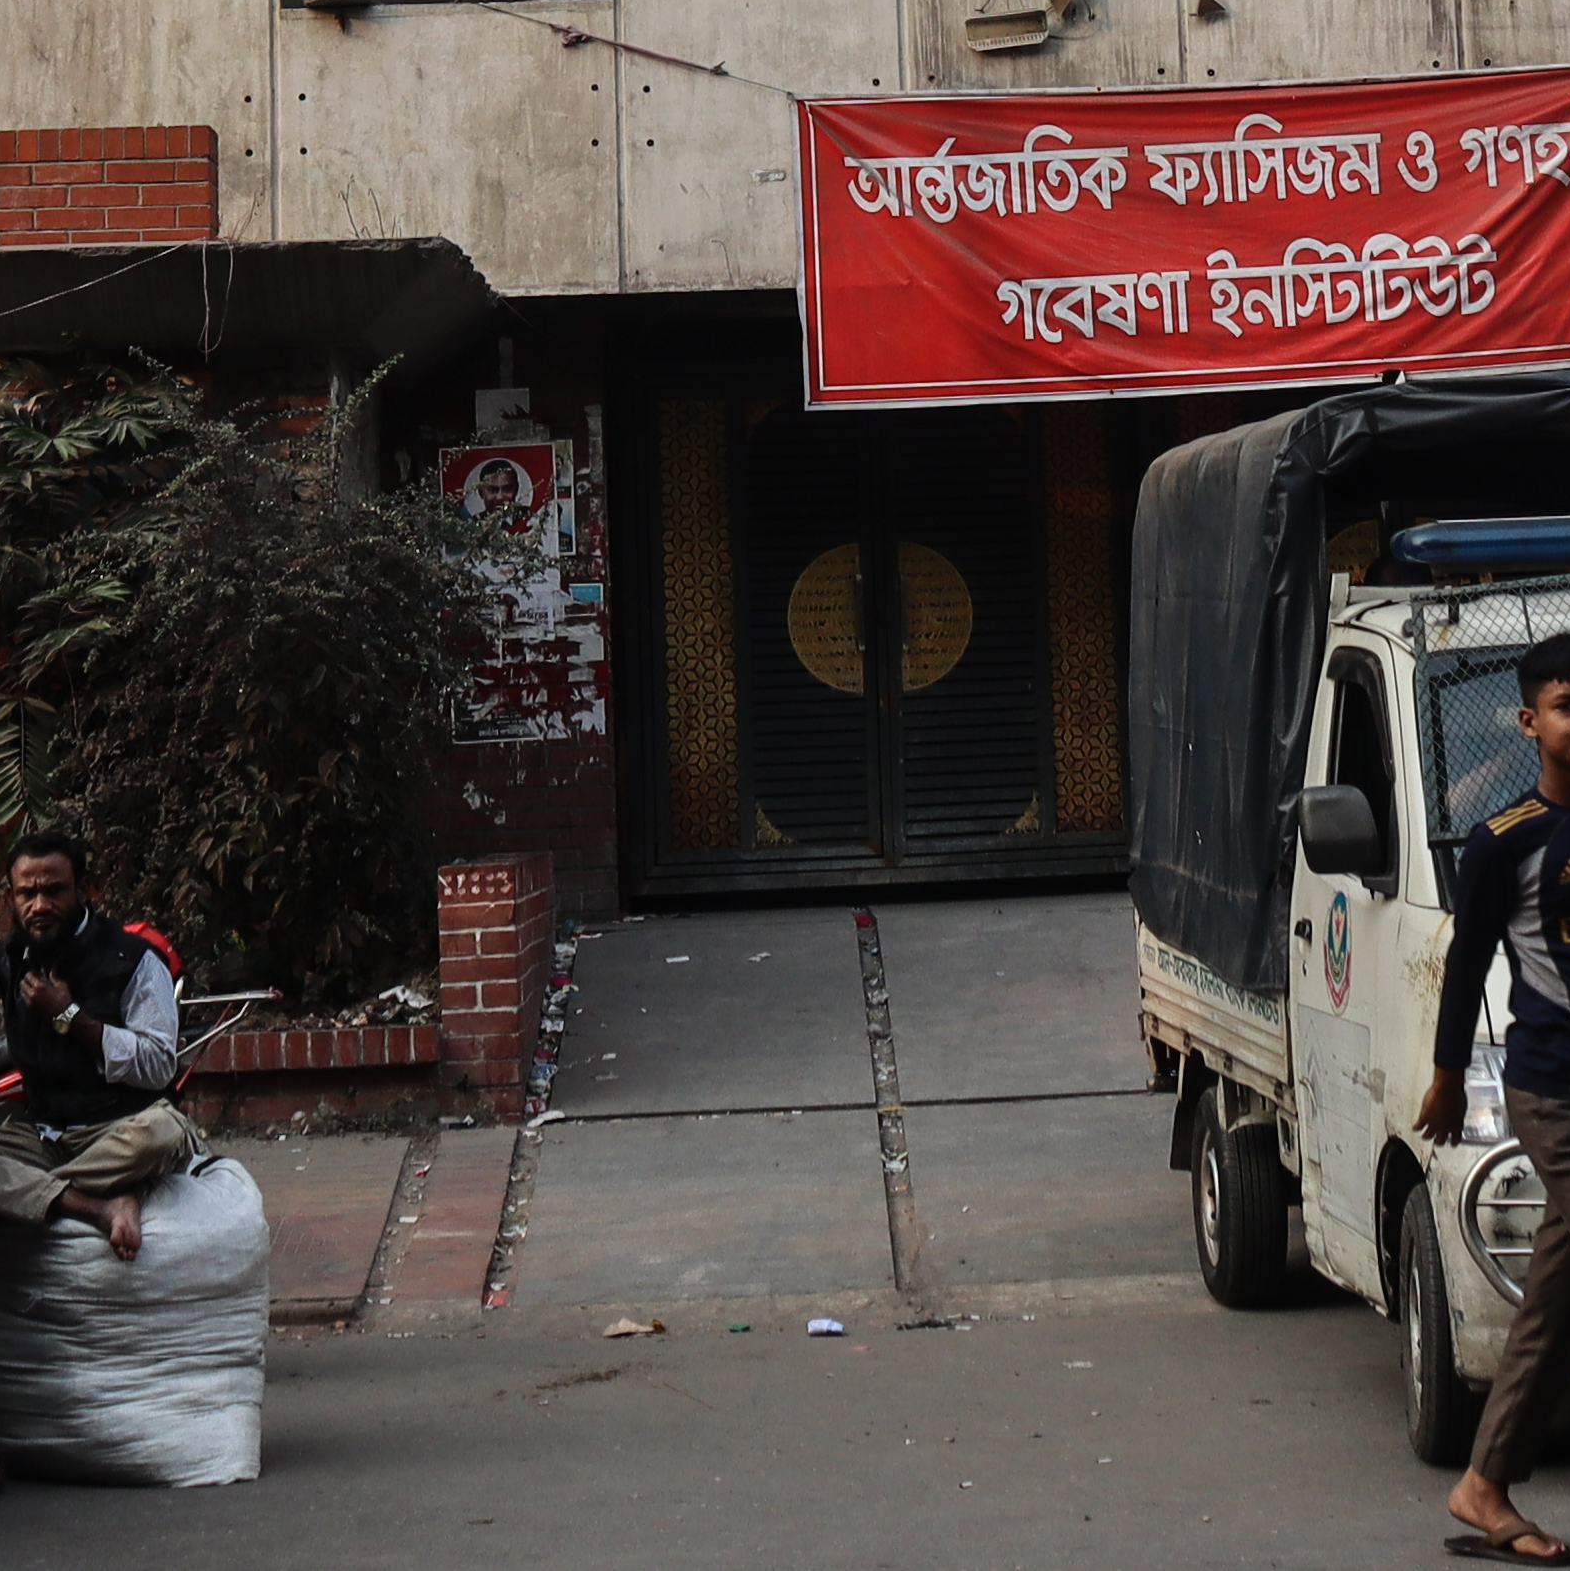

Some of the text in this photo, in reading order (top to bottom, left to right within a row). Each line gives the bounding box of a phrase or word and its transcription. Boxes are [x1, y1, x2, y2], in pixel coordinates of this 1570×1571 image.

[844, 123, 1129, 224] আর্ন্তজাতিক
[1144, 113, 1382, 206] ফ্যাসিজম
[1397, 130, 1439, 193] ও
[996, 232, 1498, 344] গবেষণা ইনস্টিটিউট
